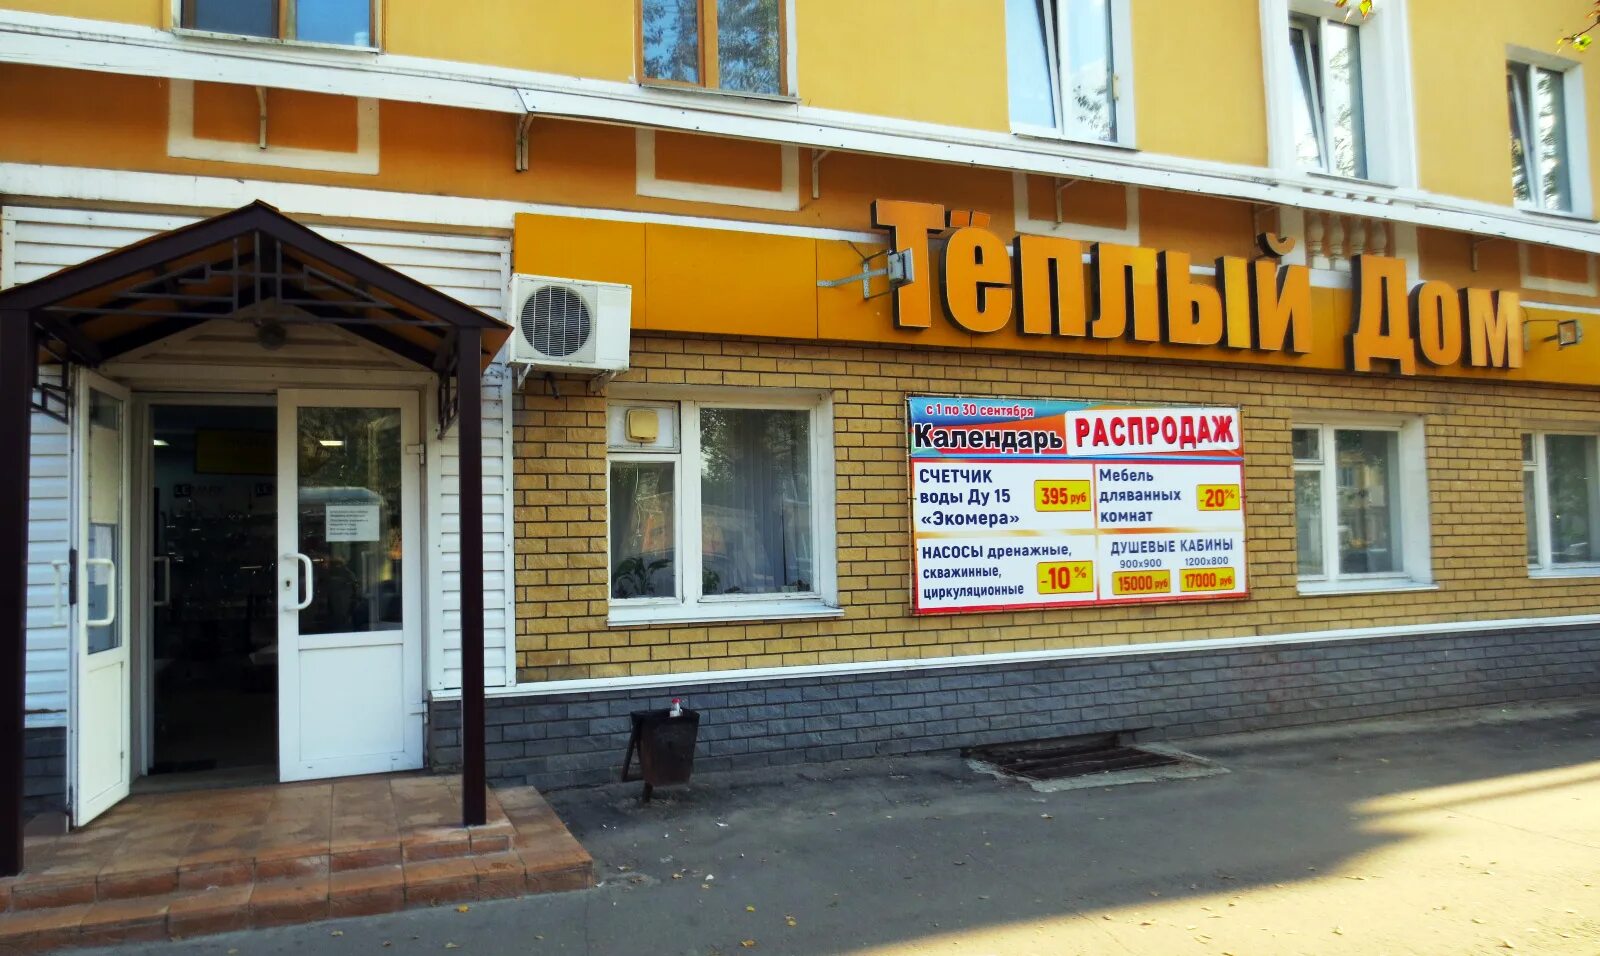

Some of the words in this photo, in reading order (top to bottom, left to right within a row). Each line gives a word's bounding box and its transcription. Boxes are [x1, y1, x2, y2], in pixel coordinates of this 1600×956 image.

[872, 199, 1311, 355] Тёплый
[1351, 254, 1524, 376] Дом
[926, 405, 933, 415] с
[936, 404, 941, 415] 1
[945, 405, 959, 415] по
[963, 404, 977, 415] 30
[980, 406, 1034, 417] сентября
[914, 424, 1063, 454] Календарь
[1075, 415, 1234, 449] РАСПРОДАЖ
[919, 469, 993, 483] СЧЕТЧИК
[1099, 468, 1154, 482] Мебель
[920, 492, 963, 505] воды
[967, 489, 990, 506] Ду
[994, 489, 1011, 502] 15
[1041, 488, 1068, 505] 395
[1070, 493, 1087, 505] руб
[1099, 490, 1182, 503] дляванных
[921, 511, 1020, 528] «Экомера»
[1100, 511, 1153, 523] комнат
[922, 546, 983, 559] НАСОСЫ
[987, 545, 1072, 559] дренажные,
[1110, 540, 1176, 556] ДУШЕВЫЕ
[1180, 538, 1233, 552] КАБИНЫ
[923, 566, 1002, 579] скважинные,
[1119, 575, 1152, 591] 15000
[1154, 578, 1169, 590] руб
[1185, 573, 1216, 588] 17000
[1219, 576, 1233, 587] руб
[923, 584, 1024, 600] циркуляционные
